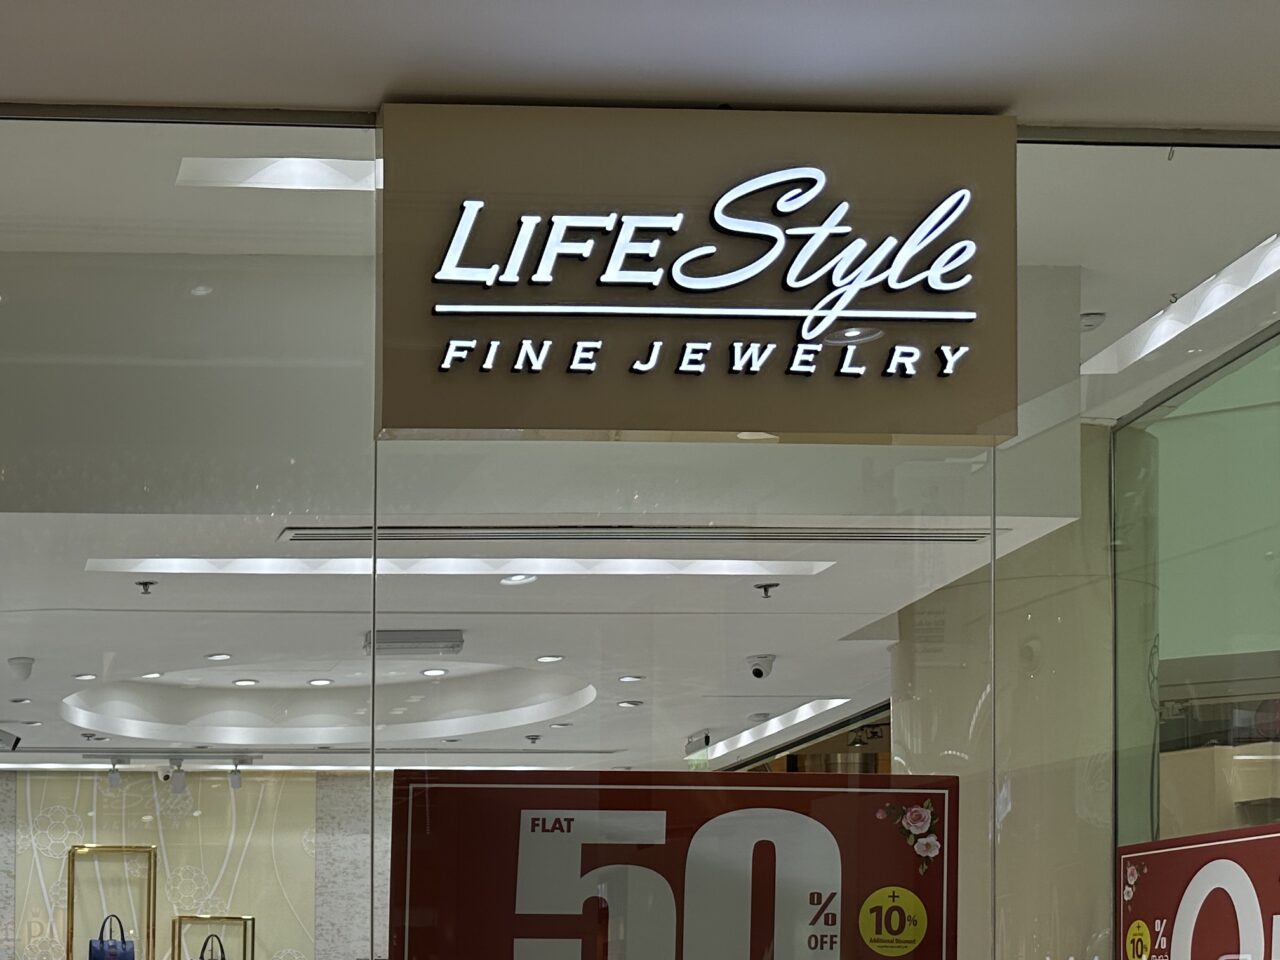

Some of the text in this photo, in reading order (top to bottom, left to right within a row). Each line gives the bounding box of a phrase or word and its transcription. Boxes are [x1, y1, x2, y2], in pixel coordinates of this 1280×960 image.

[441, 339, 970, 376] FINE JEWELRY
[530, 817, 574, 833] FLAT
[869, 905, 918, 936] 10%
[808, 934, 838, 950] OFF
